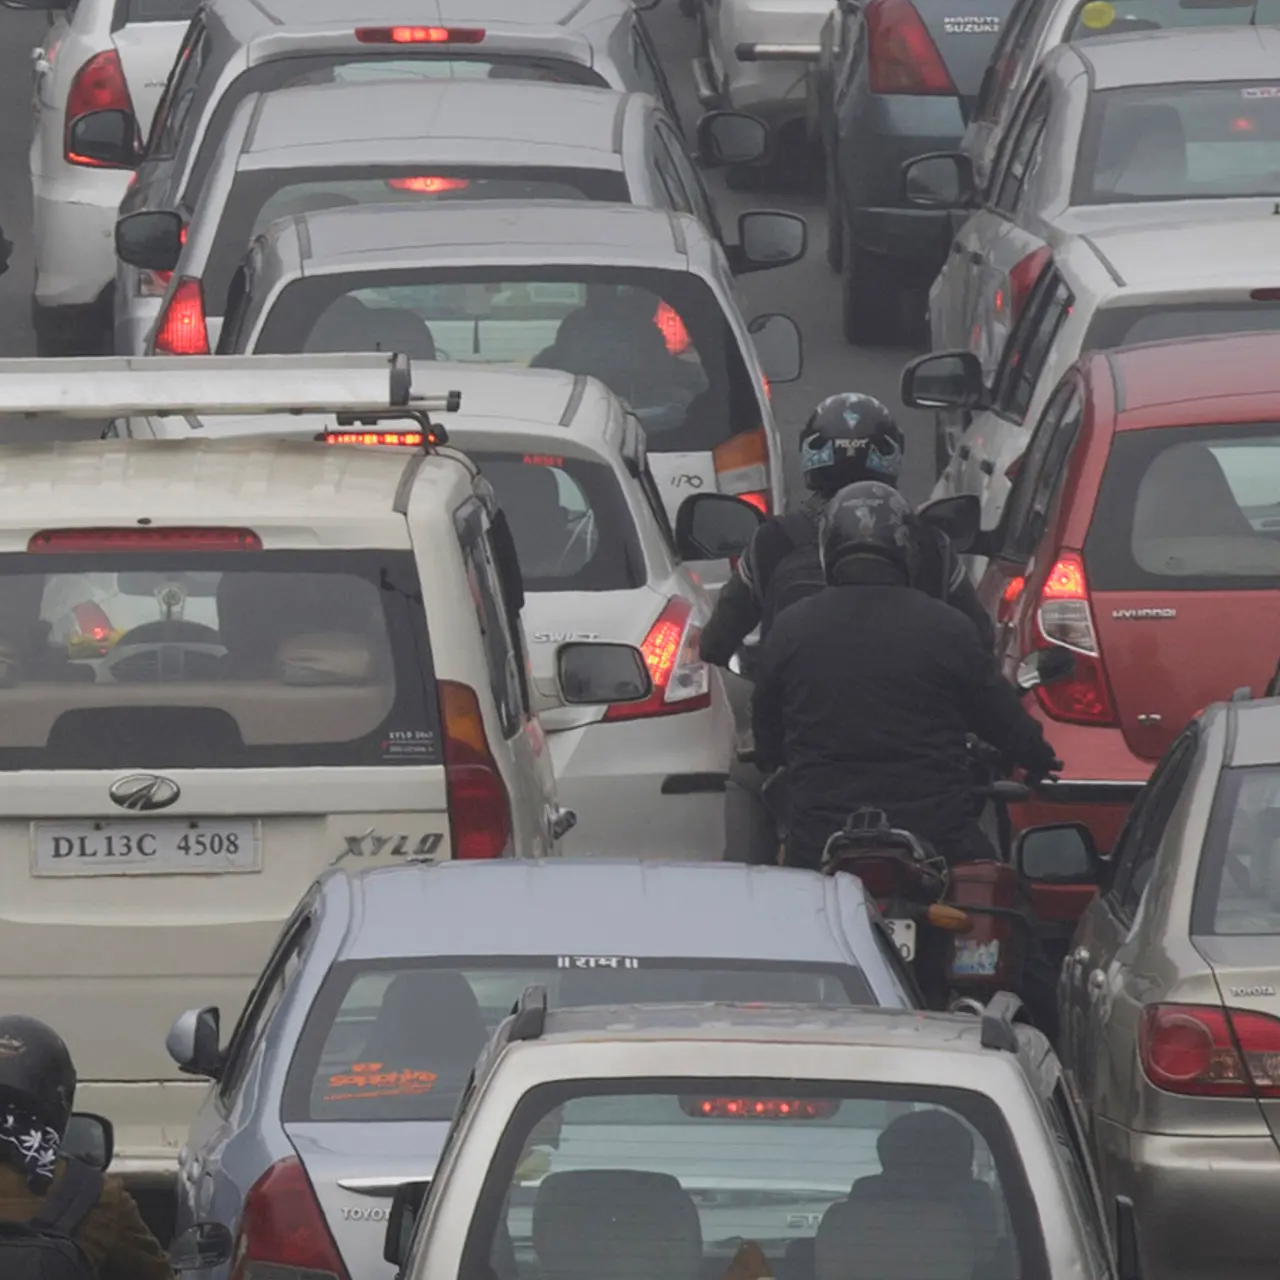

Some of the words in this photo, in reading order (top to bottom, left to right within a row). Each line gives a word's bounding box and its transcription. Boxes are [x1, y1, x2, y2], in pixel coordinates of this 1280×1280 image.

[945, 23, 1000, 33] SUZUKI
[51, 834, 157, 860] DL13C
[176, 831, 240, 857] 4508
[1229, 984, 1277, 997] TOYOTA
